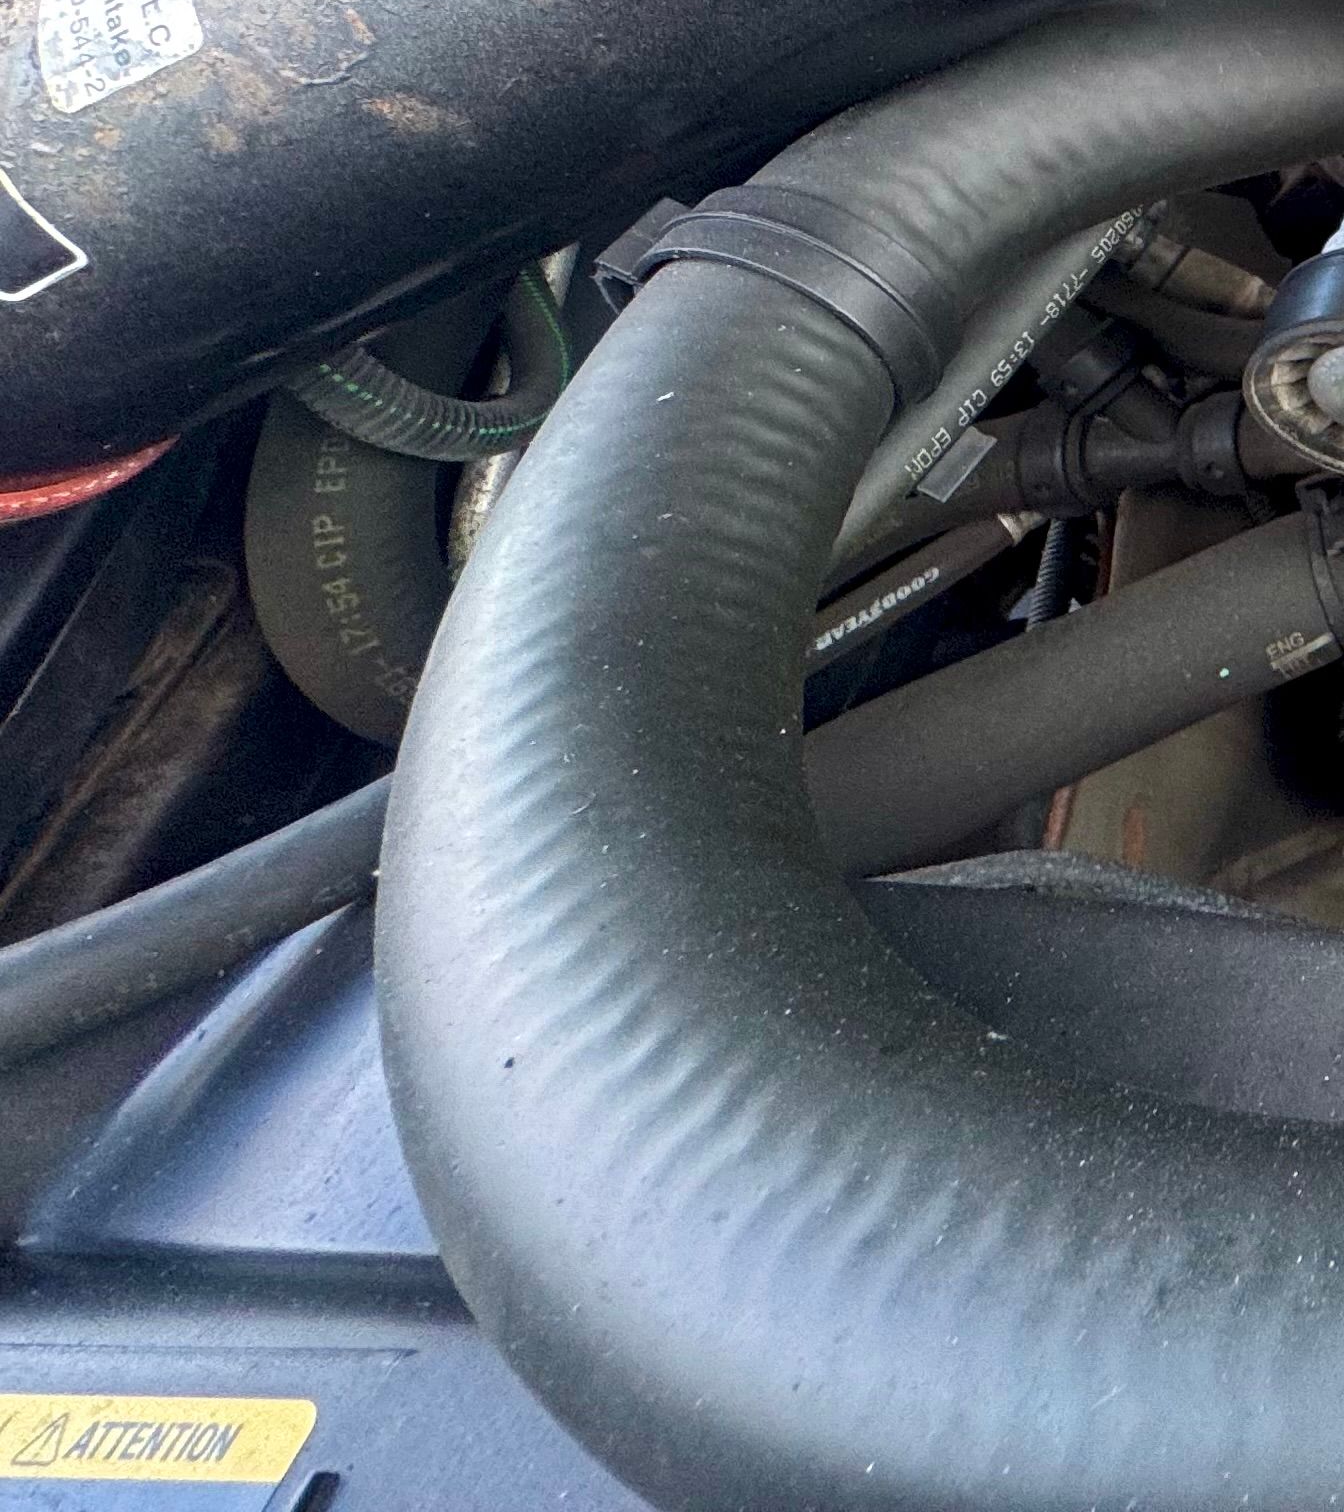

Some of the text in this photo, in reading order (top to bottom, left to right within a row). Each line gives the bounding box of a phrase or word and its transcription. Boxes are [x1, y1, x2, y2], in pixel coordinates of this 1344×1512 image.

[990, 331, 1036, 387] 13:59
[958, 389, 988, 427] CIP
[313, 514, 346, 569] CIP
[814, 567, 940, 651] GOODYEAR
[1265, 632, 1305, 656] ENG
[61, 1420, 244, 1464] ATTENTION
